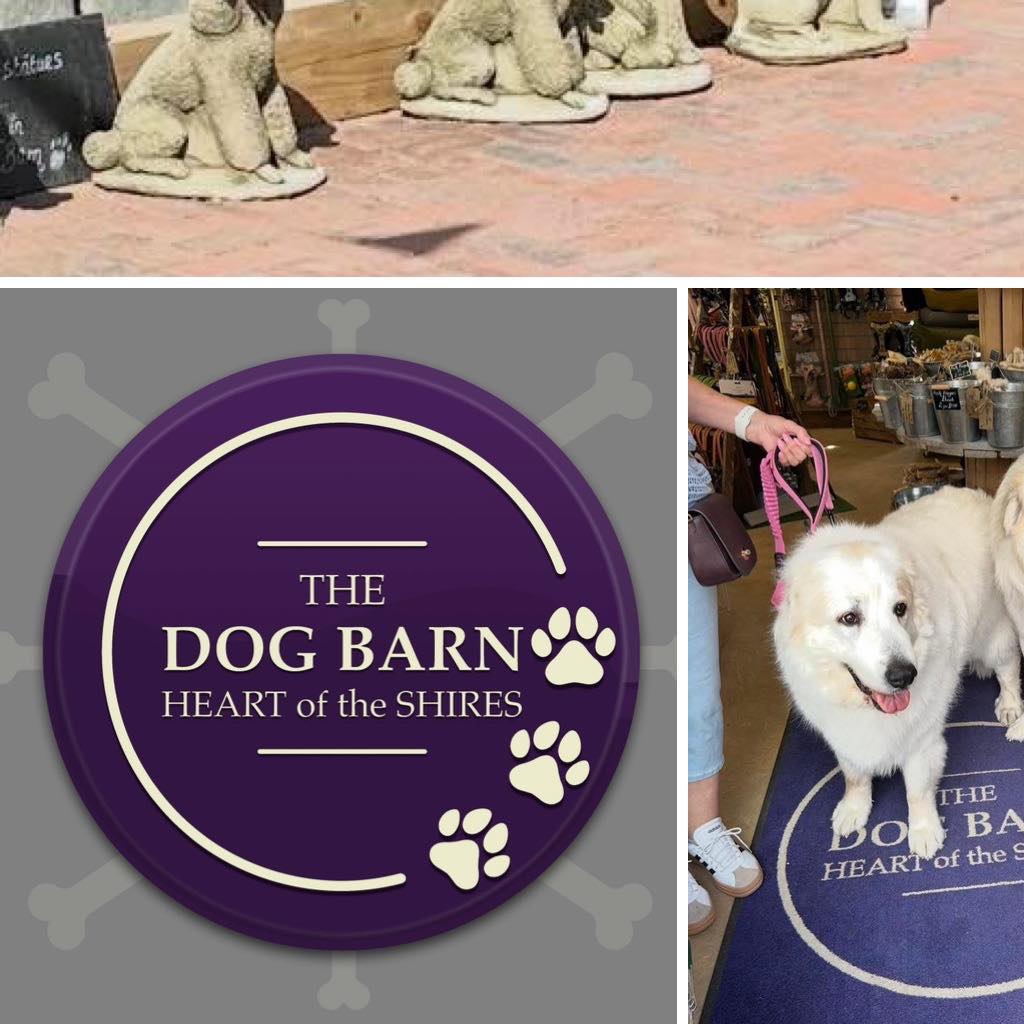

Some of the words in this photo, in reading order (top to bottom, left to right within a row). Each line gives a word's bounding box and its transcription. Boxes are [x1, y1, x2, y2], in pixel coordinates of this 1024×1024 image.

[299, 574, 386, 606] THE
[161, 625, 317, 672] DOG
[336, 626, 524, 672] BARN
[161, 690, 287, 718] HEART
[296, 689, 329, 718] of
[337, 688, 387, 718] the
[396, 690, 523, 718] SHIRES
[936, 784, 998, 806] THE
[828, 817, 948, 852] DO
[820, 854, 923, 882] HEART
[934, 850, 961, 869] of
[967, 845, 1007, 866] the
